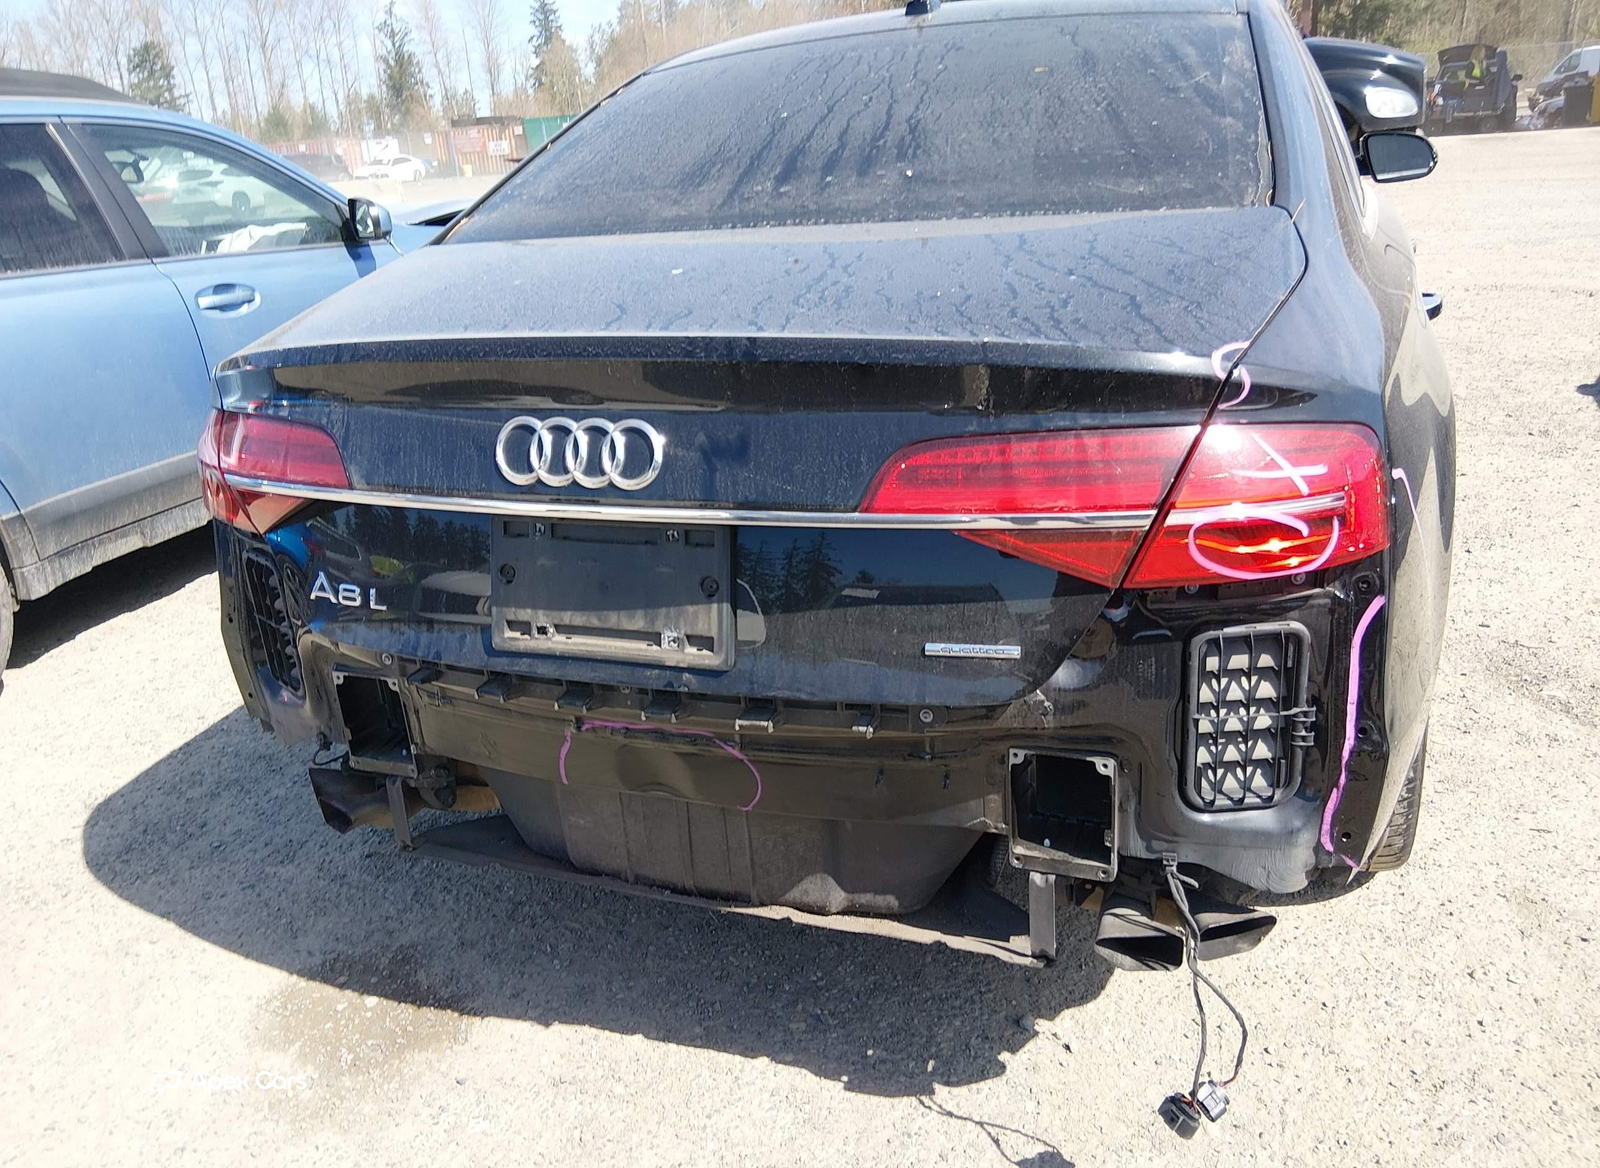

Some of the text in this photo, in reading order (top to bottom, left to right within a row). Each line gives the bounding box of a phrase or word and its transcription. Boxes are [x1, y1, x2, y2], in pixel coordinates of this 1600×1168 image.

[310, 570, 388, 611] A8 L
[939, 646, 1006, 656] quattro
